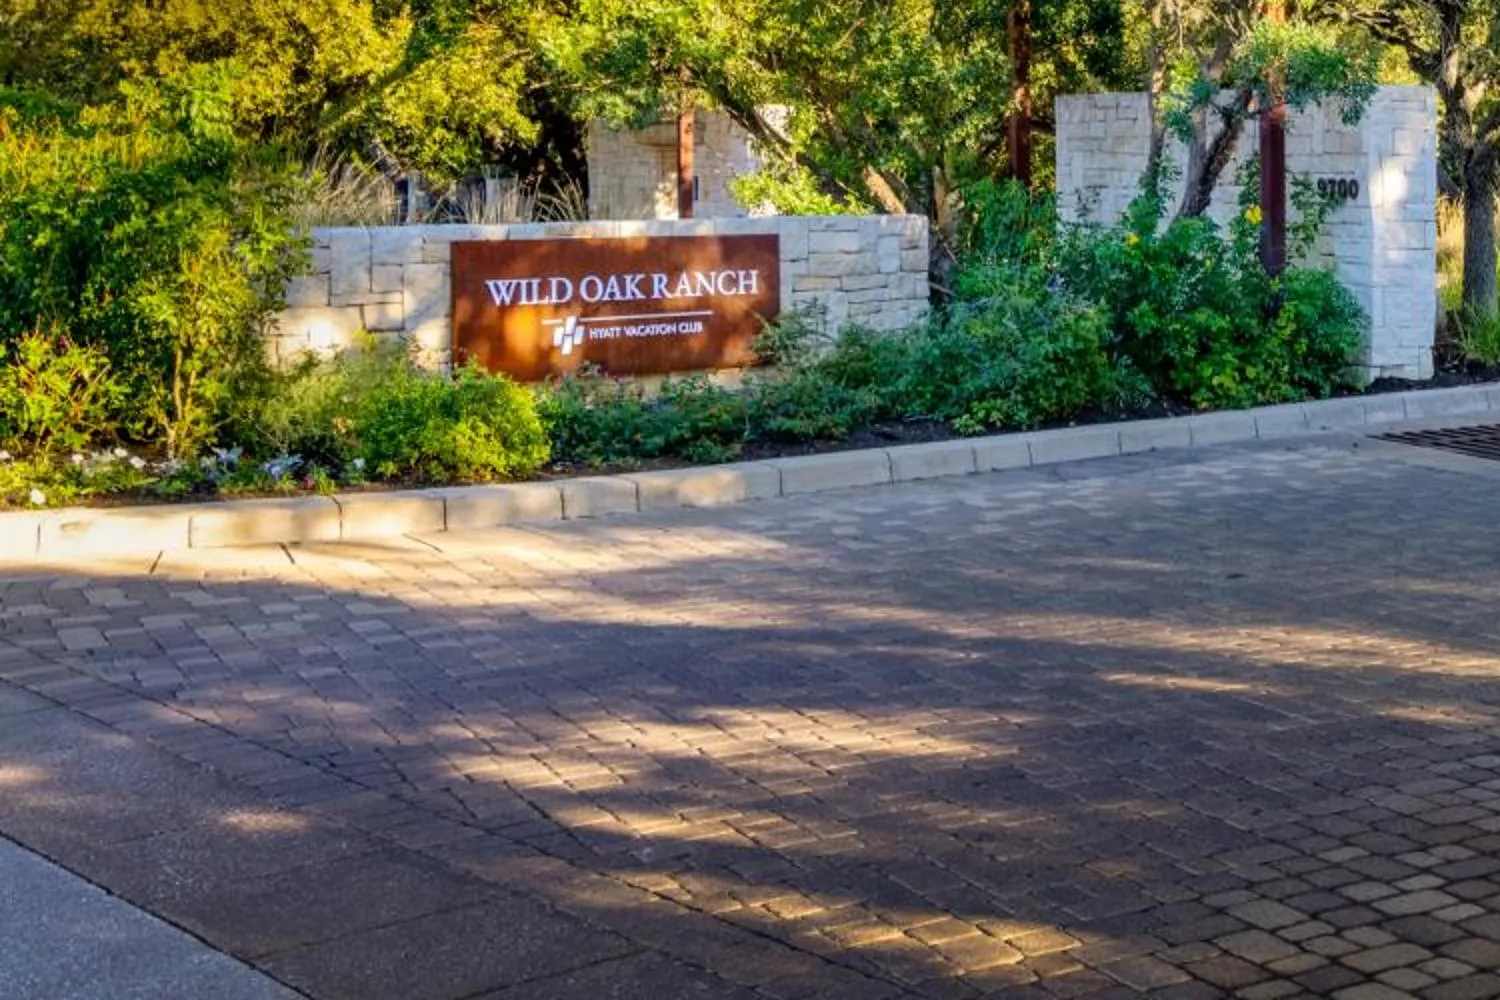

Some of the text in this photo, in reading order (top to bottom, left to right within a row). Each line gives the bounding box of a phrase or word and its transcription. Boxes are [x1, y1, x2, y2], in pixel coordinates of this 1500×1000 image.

[1317, 177, 1359, 200] 9700
[485, 269, 760, 306] WILD OAK RANCH
[589, 320, 704, 340] HYATT VACATION CLUB
